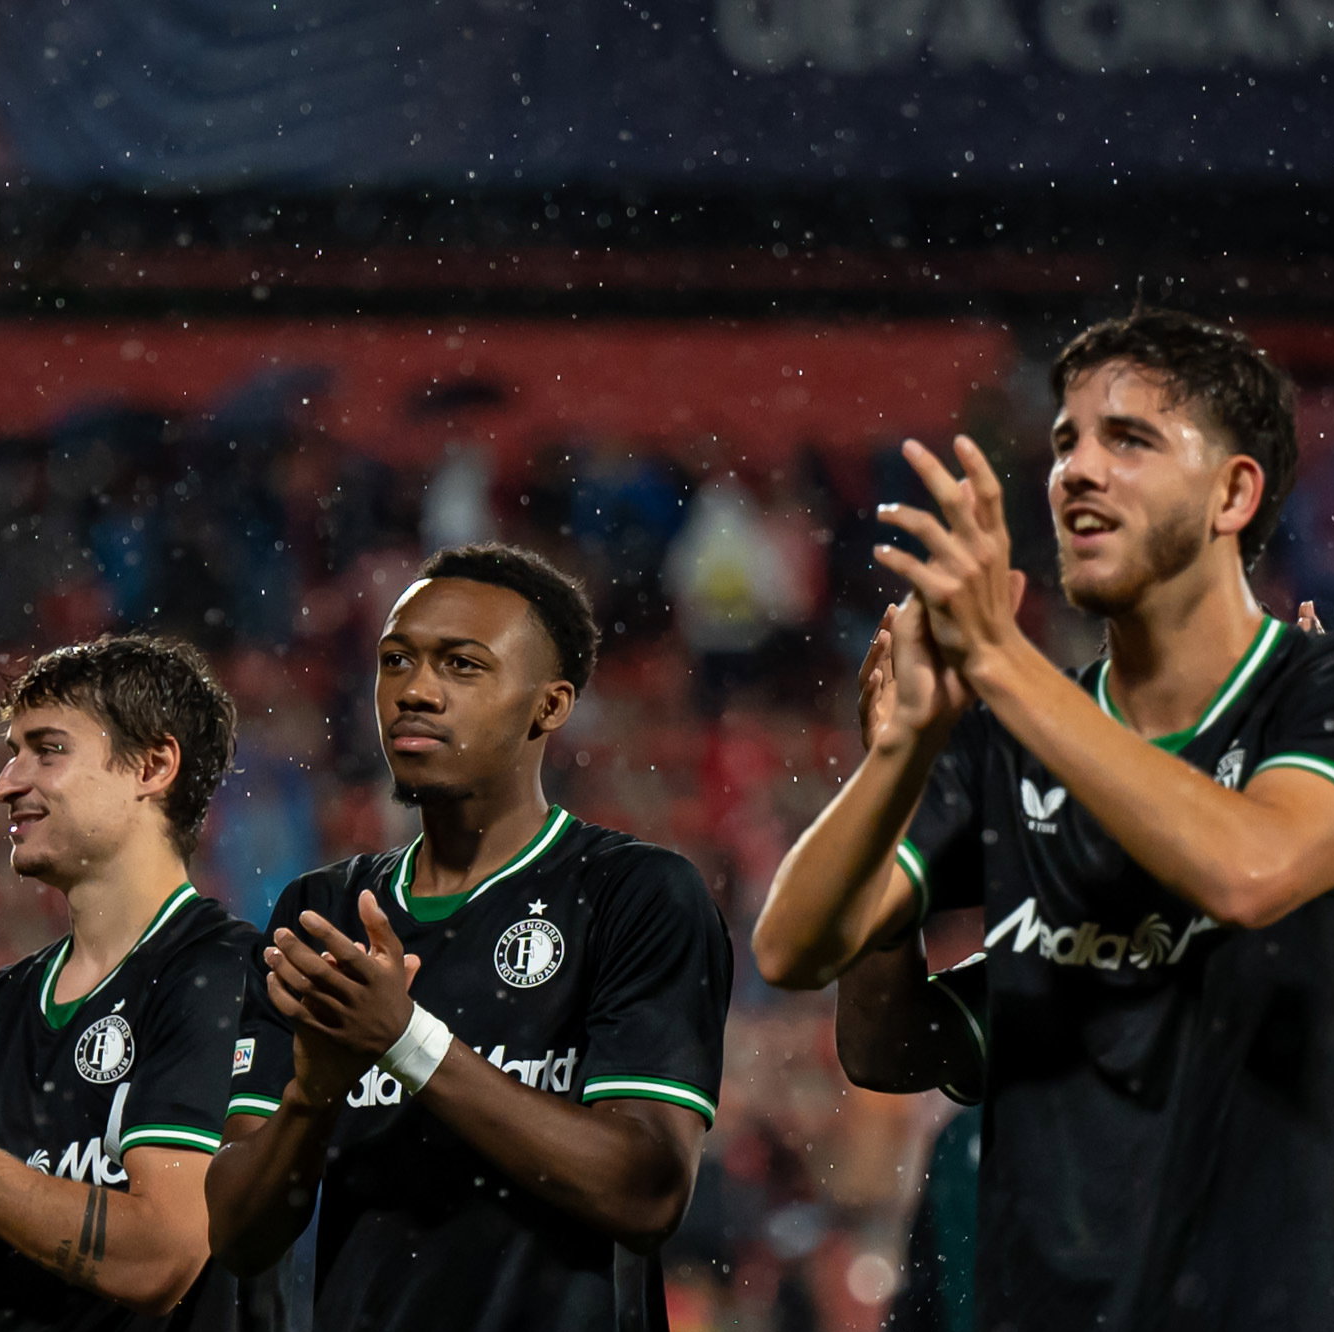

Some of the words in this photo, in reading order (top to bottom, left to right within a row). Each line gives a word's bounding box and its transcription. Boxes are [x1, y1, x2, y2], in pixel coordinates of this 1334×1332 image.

[501, 921, 560, 945] FEYENOORD
[499, 960, 558, 985] ROTTERDAM
[78, 1057, 130, 1081] ROTTERDAM
